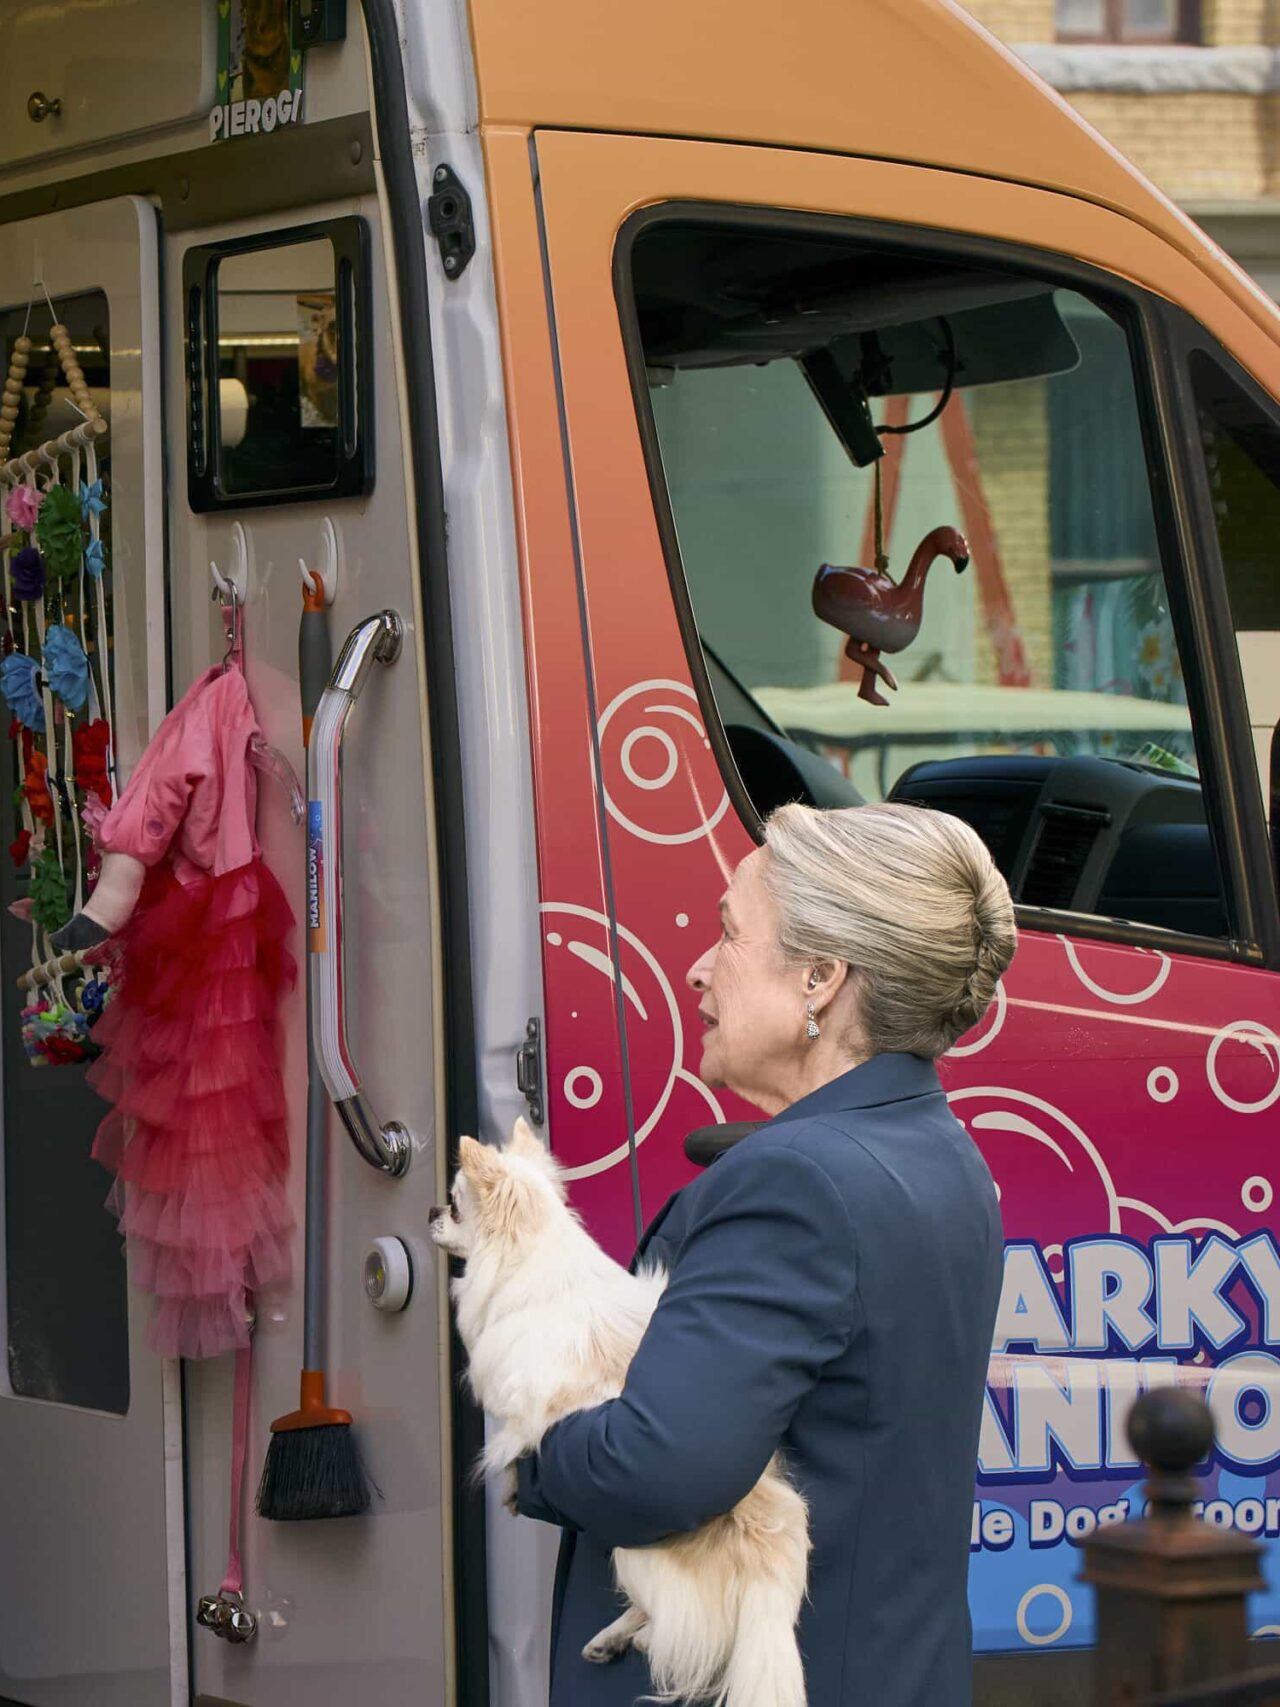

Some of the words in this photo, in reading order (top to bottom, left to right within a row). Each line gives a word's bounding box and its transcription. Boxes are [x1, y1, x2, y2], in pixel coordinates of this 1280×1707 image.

[208, 88, 303, 142] PIEROGI
[308, 847, 319, 928] MANILOW
[988, 1232, 1280, 1354] ARK
